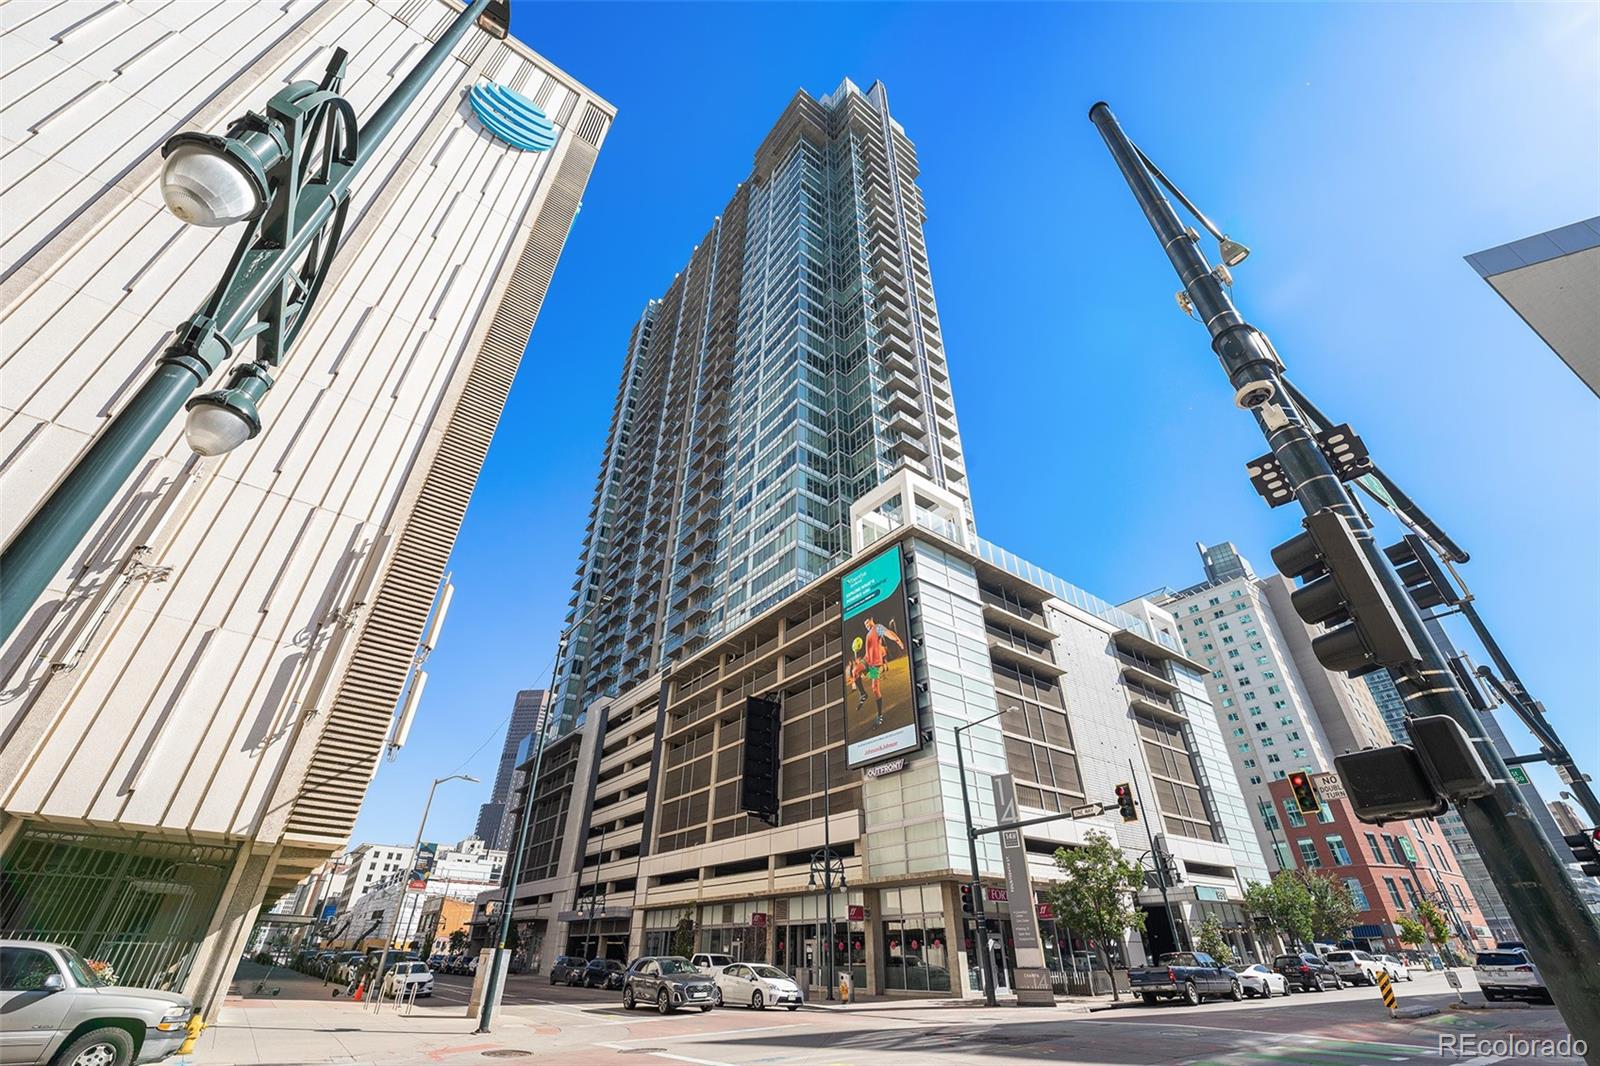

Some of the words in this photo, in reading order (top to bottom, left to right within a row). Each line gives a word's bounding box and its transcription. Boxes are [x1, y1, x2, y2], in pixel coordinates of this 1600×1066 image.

[1322, 775, 1338, 785] NO
[1319, 784, 1344, 793] DOUBL
[1326, 791, 1346, 799] TURN
